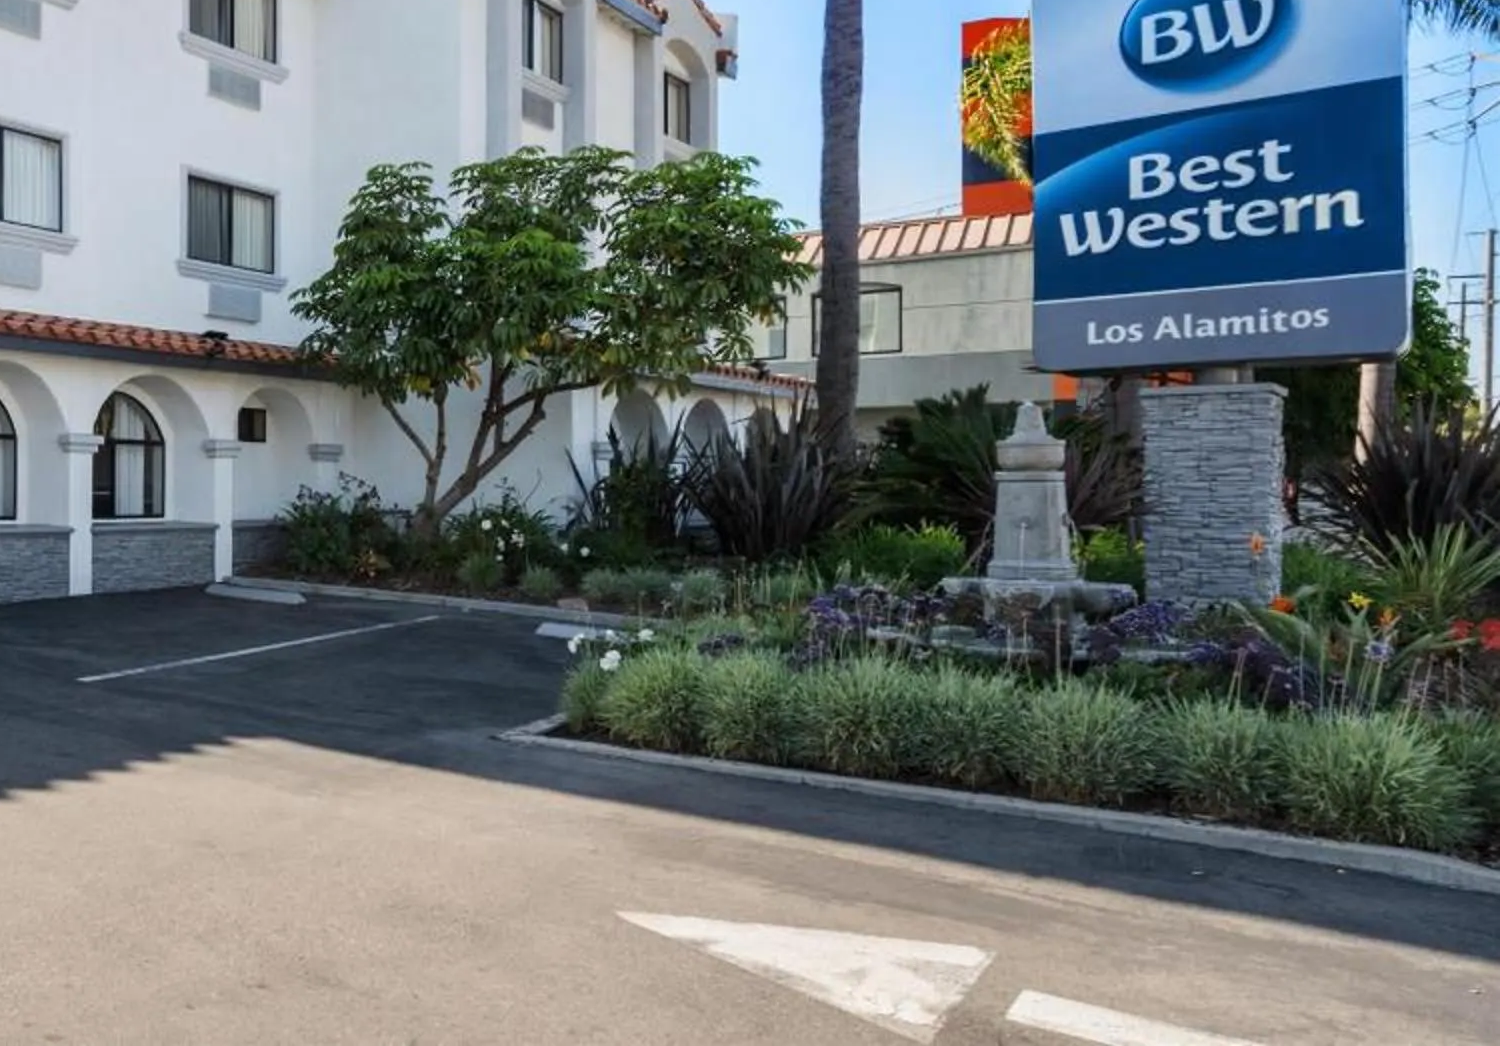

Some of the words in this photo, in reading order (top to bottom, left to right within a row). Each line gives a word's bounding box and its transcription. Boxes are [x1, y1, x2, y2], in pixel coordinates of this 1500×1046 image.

[1128, 139, 1293, 200] Best
[1059, 189, 1364, 257] Western
[1087, 321, 1143, 345] Los
[1153, 307, 1329, 341] Alamitos
